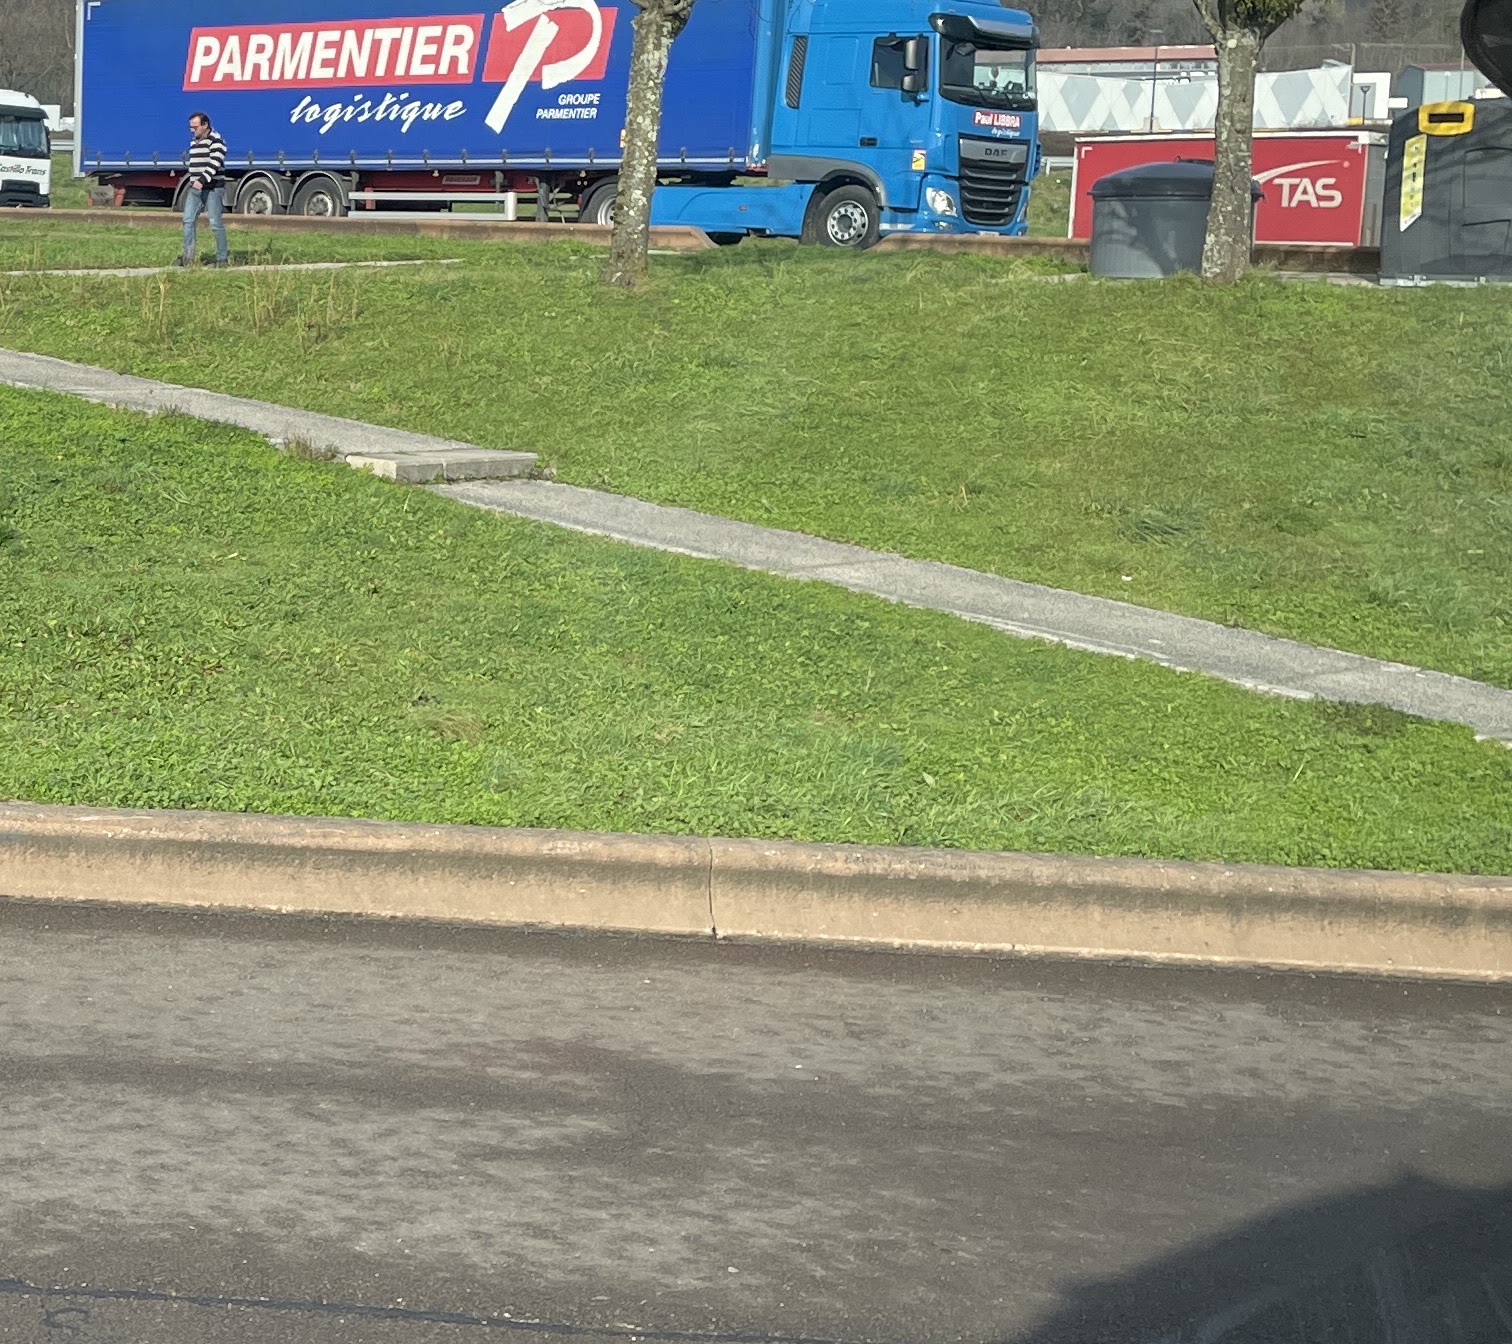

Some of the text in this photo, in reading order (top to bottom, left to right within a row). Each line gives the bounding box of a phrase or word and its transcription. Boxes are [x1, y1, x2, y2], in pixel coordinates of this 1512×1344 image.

[190, 25, 475, 83] PARMENTIER
[558, 93, 601, 105] GROUPE
[289, 91, 468, 135] logistique
[535, 107, 598, 120] PARMENTIER
[974, 111, 993, 125] Paul
[984, 148, 1008, 156] DAF
[1272, 177, 1343, 208] TAS
